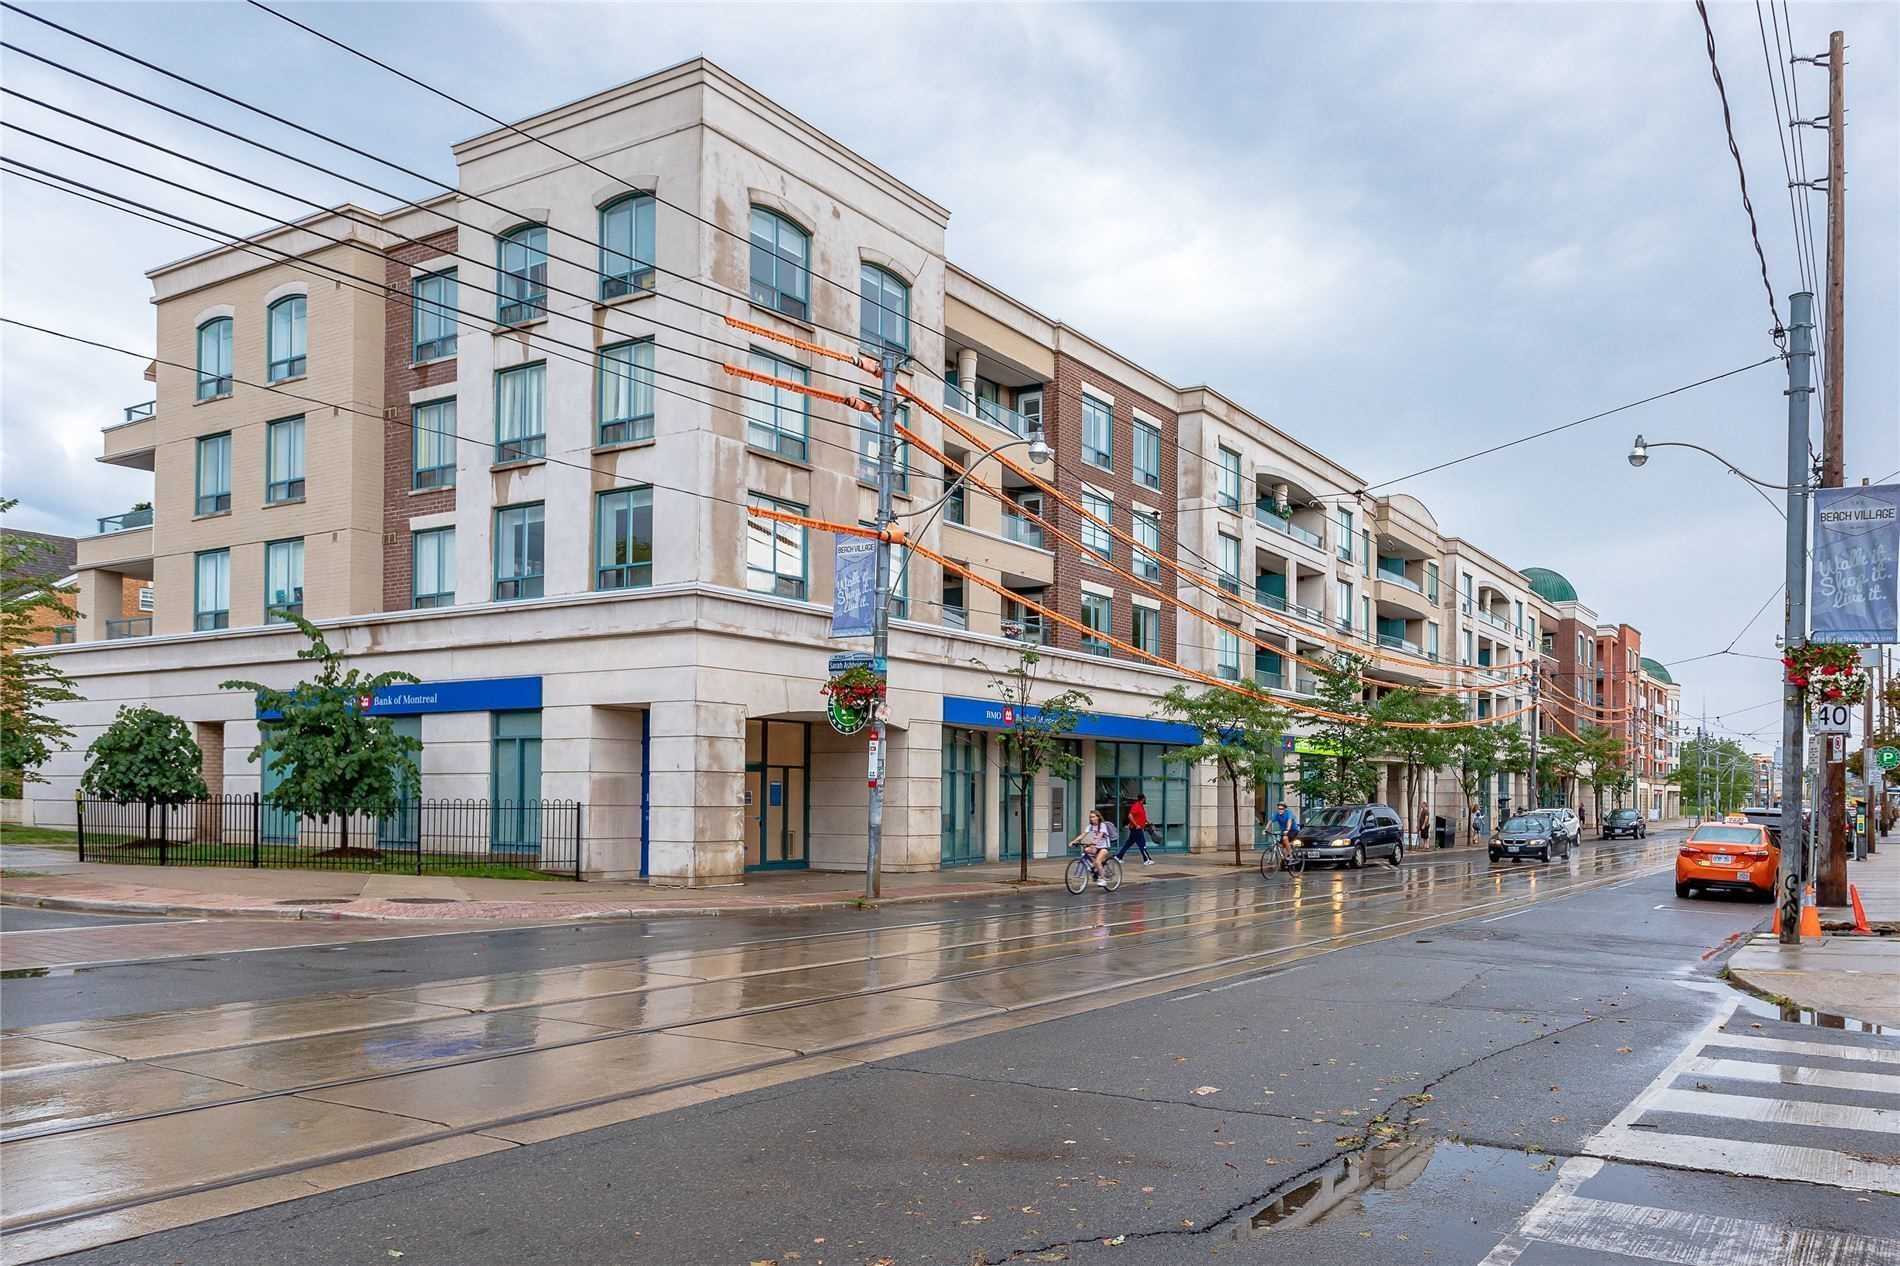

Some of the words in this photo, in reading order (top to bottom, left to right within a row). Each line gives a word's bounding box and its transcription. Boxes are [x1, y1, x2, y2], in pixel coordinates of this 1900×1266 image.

[1820, 511, 1852, 522] BEACH
[1854, 508, 1895, 520] VILLAGE
[838, 546, 854, 554] BEACH
[854, 543, 875, 552] VILLAGE
[1820, 571, 1869, 596] Shop
[374, 696, 392, 706] Bank
[393, 695, 402, 705] of
[403, 693, 438, 705] Montreal
[986, 710, 1001, 719] BMO
[1820, 706, 1847, 725] 40
[1883, 752, 1893, 762] P
